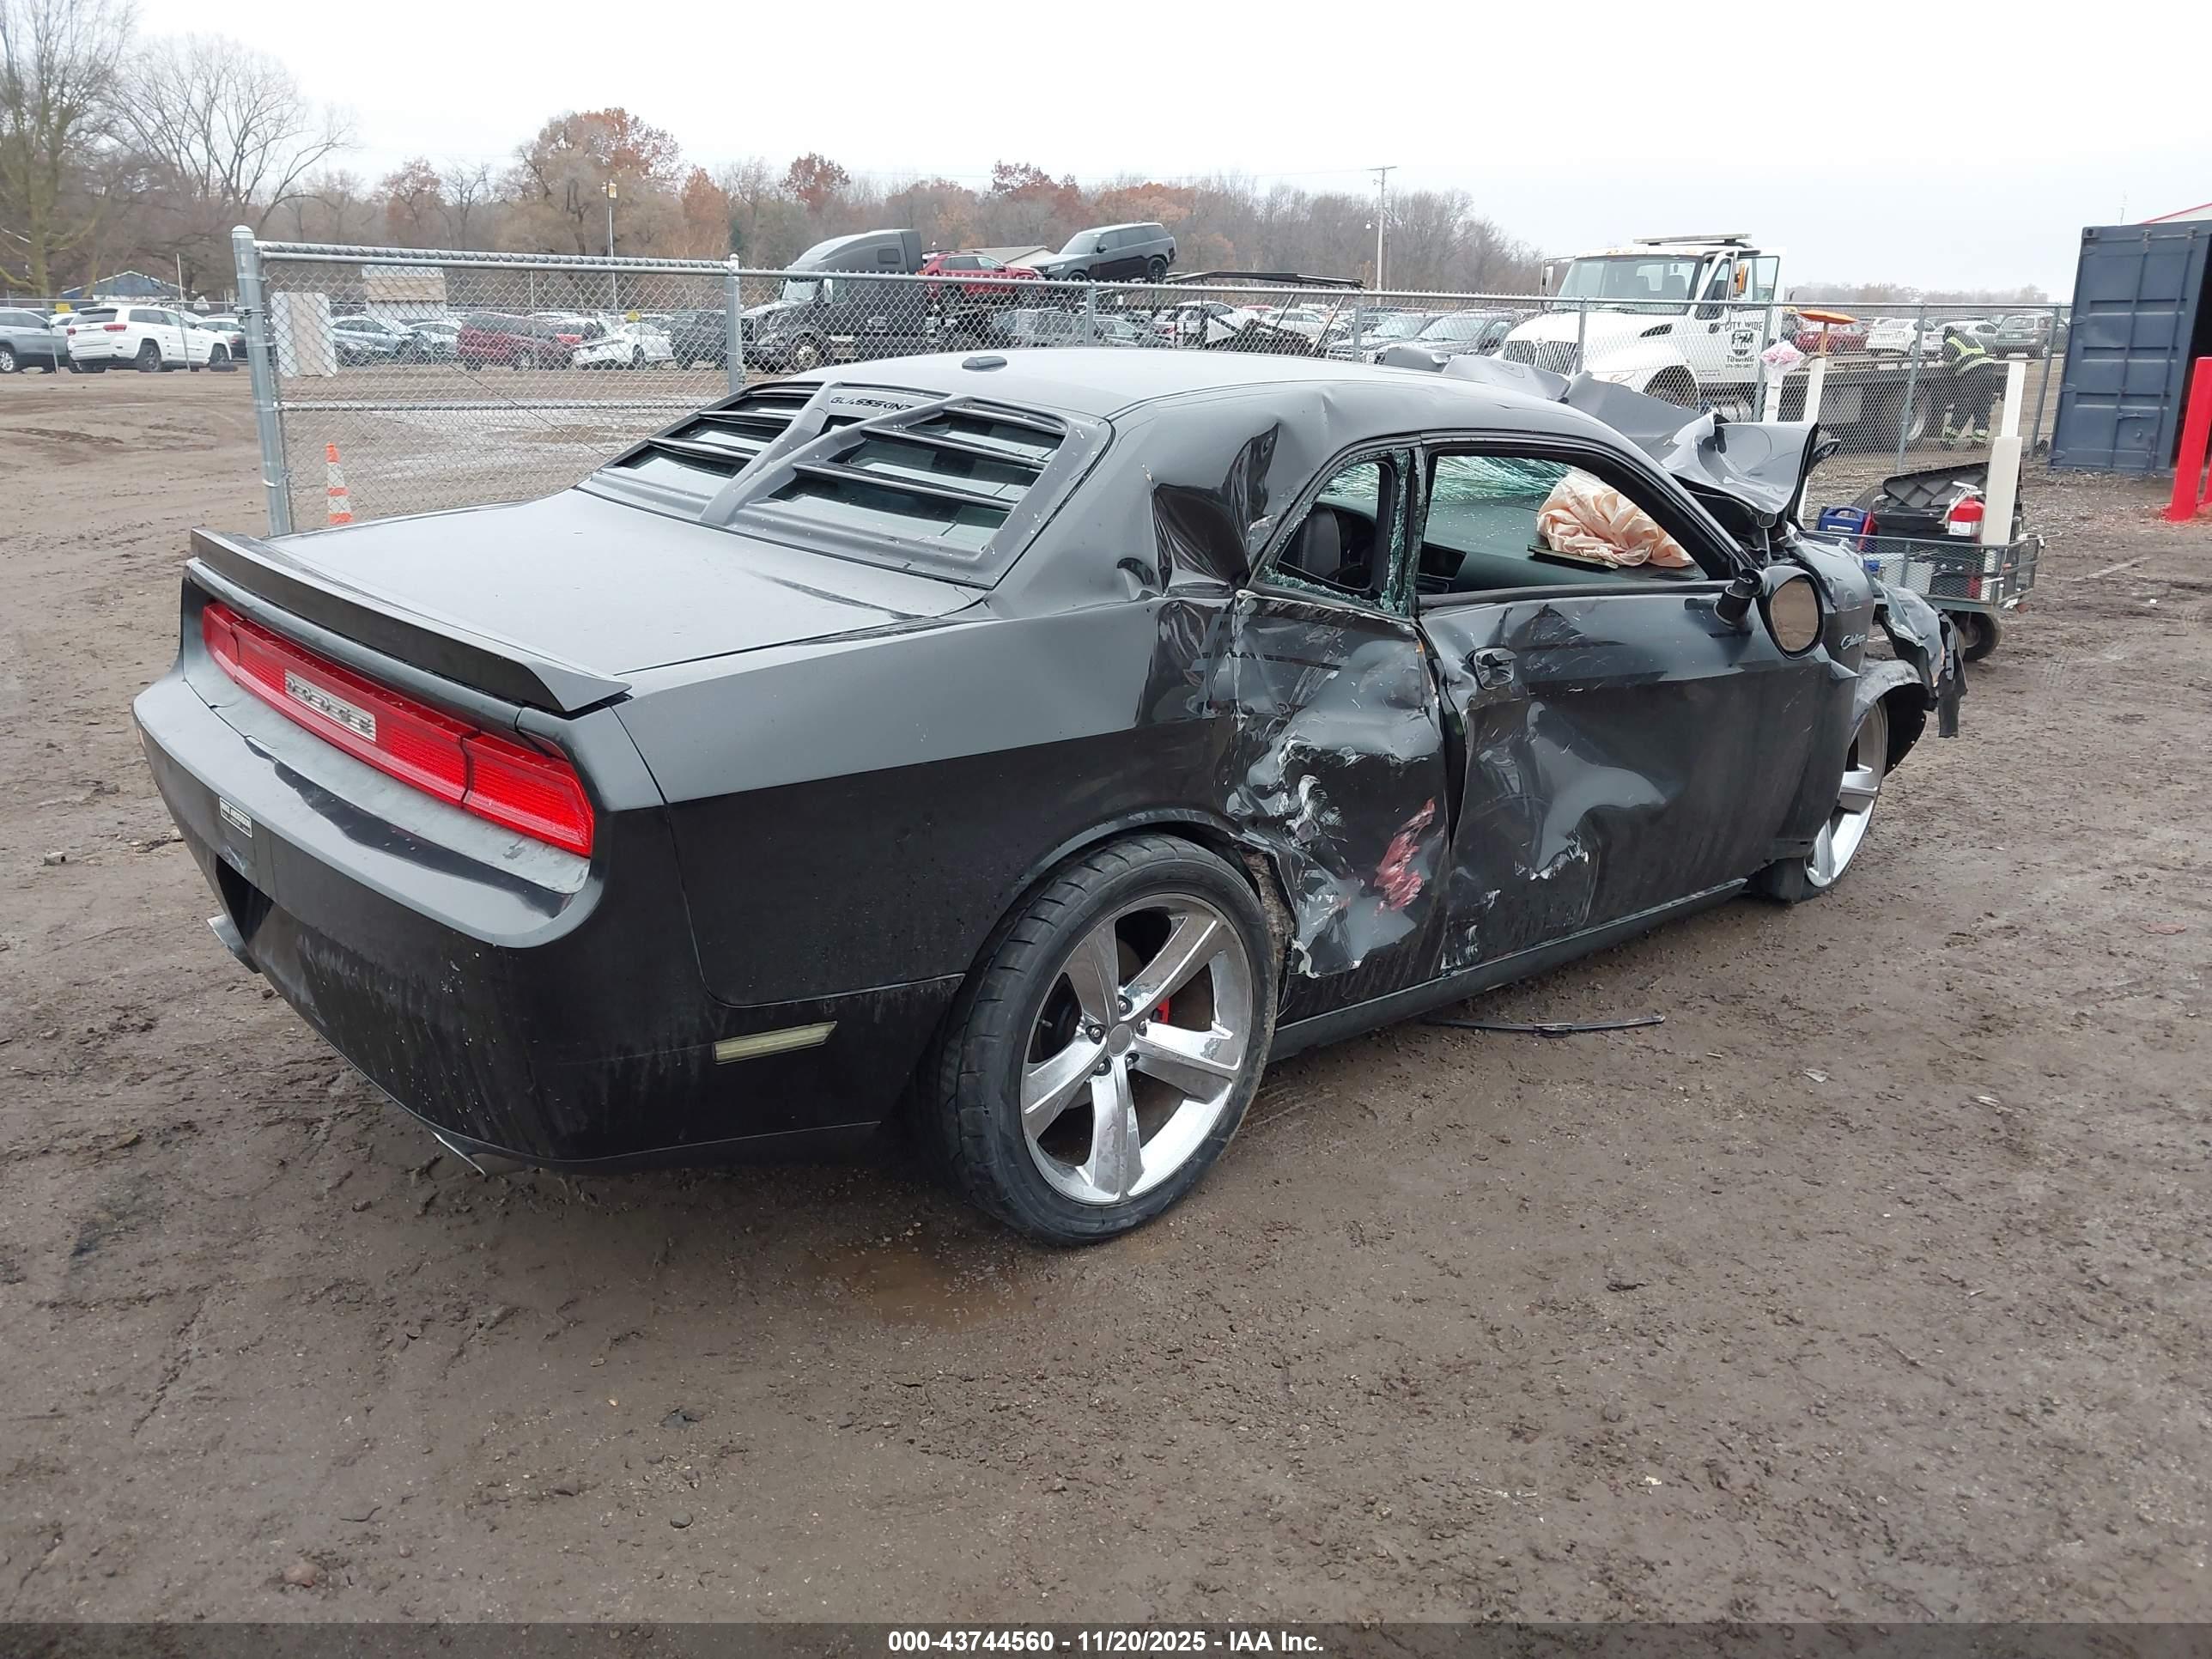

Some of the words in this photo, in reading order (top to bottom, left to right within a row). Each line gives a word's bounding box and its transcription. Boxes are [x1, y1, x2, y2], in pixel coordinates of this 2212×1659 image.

[1724, 321, 1741, 331] CITY
[1744, 321, 1764, 331] WIDE
[1726, 355, 1755, 363] TOWING
[287, 678, 372, 733] DODGE
